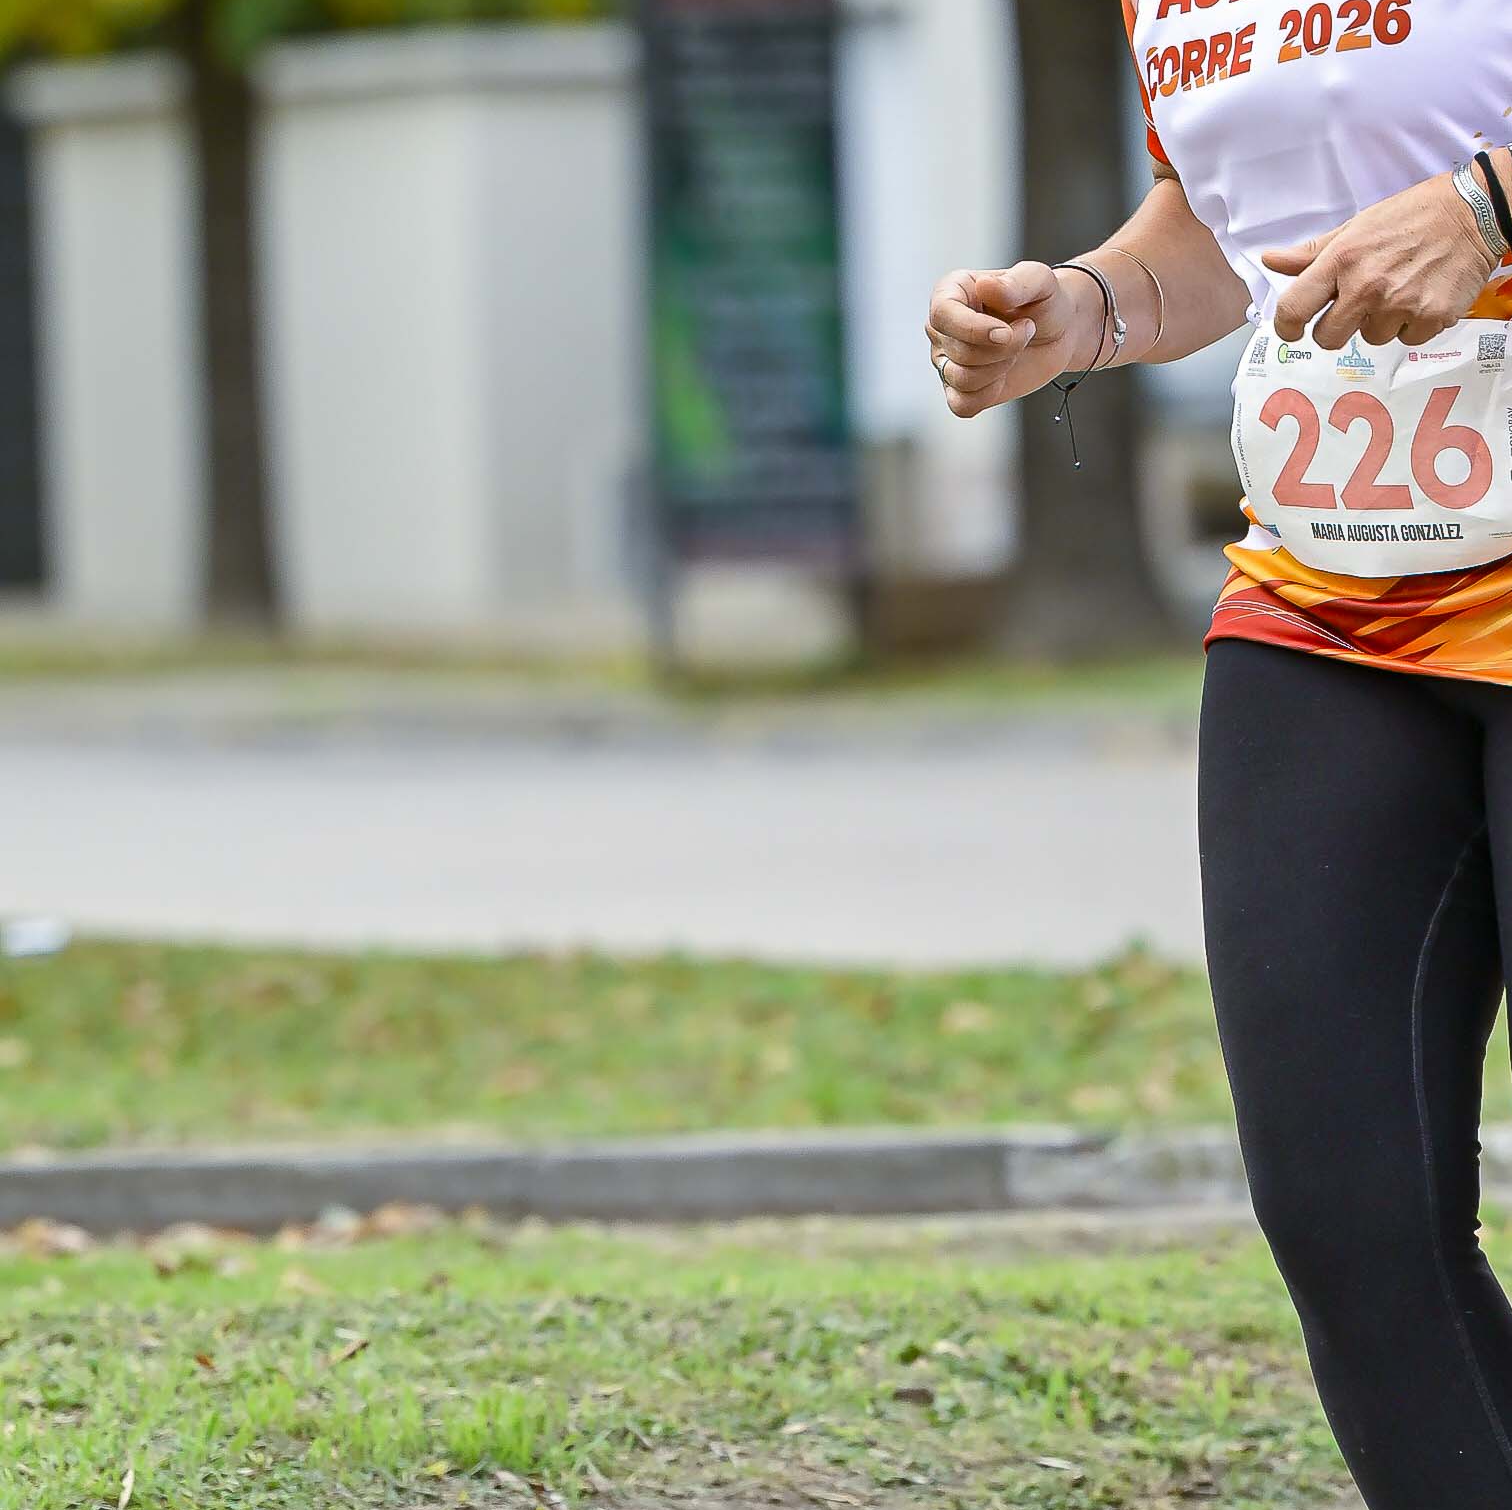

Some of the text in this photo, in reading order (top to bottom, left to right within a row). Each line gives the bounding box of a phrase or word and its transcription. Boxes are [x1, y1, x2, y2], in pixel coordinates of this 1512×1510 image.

[1146, 22, 1256, 101] CORRE
[1259, 385, 1494, 511] 226
[1310, 522, 1464, 542] MARIA AUGUSTA GONZALEZ
